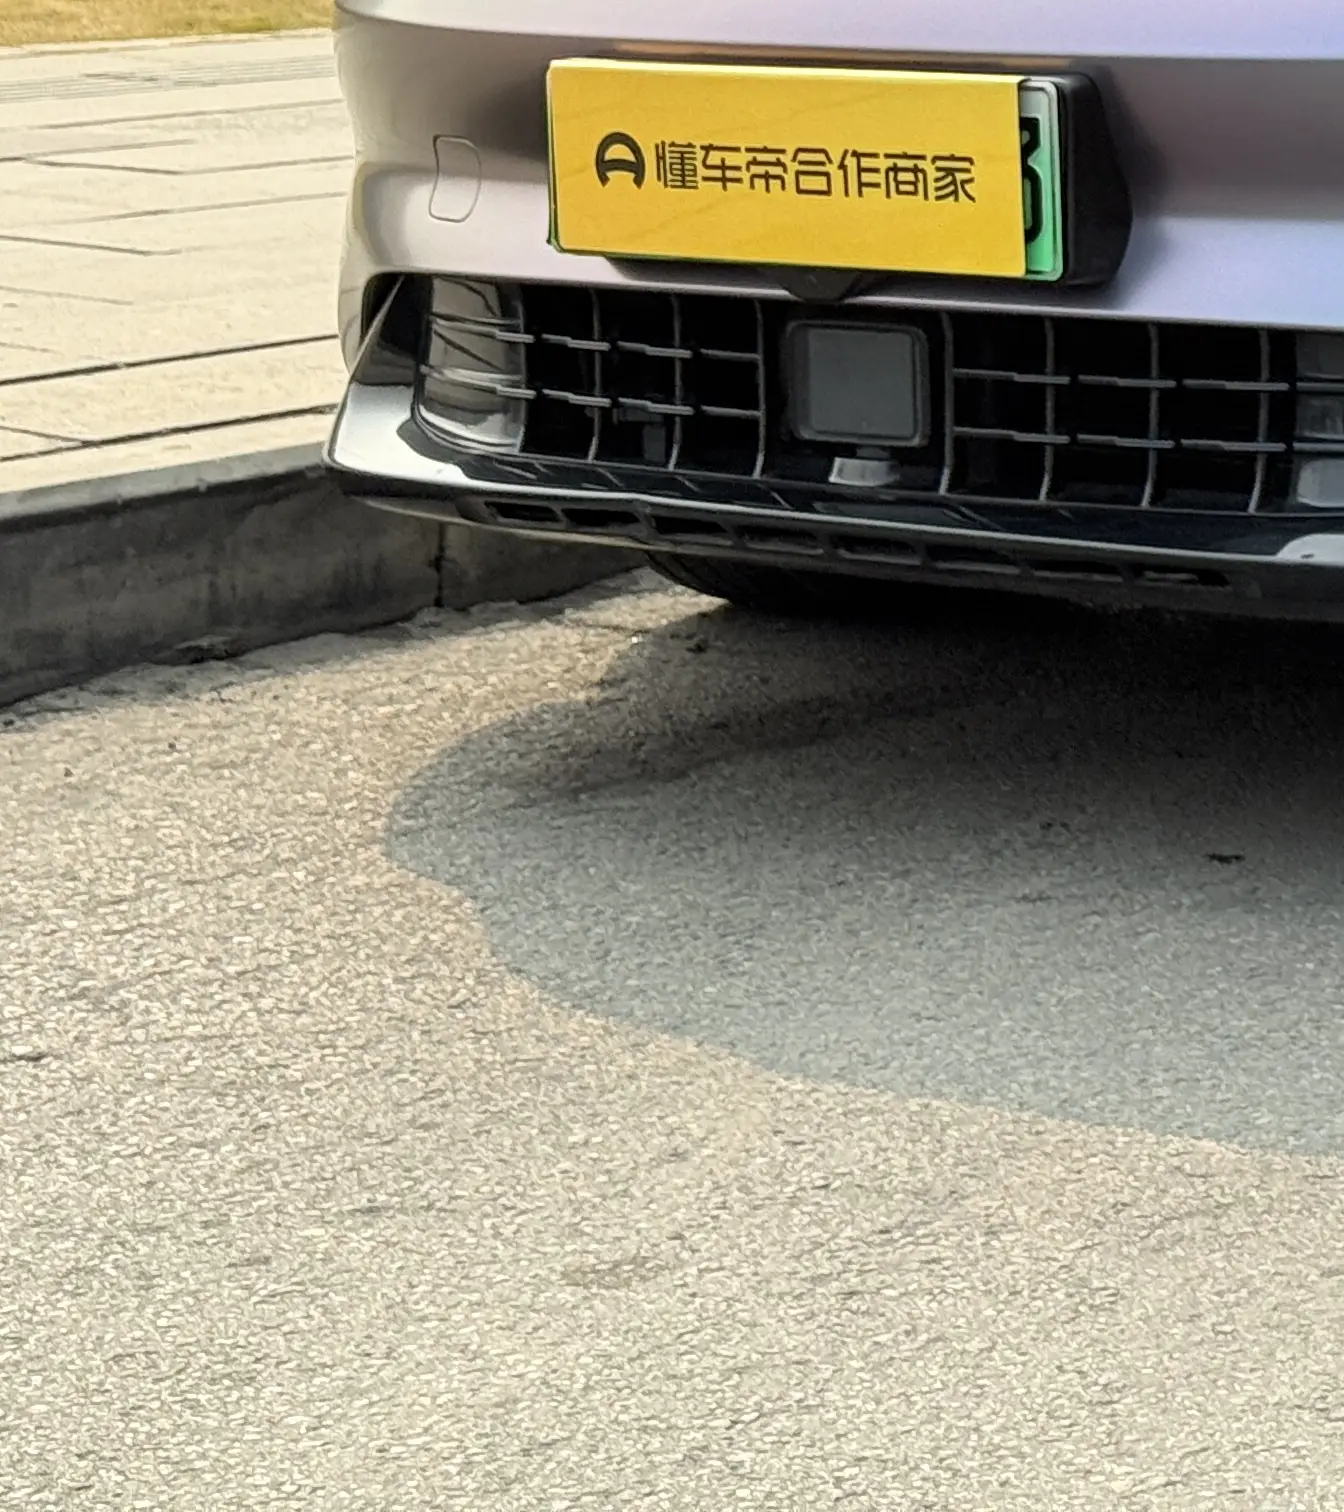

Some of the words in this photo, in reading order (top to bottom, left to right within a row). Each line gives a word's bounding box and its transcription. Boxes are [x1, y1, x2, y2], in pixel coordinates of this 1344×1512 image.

[654, 140, 976, 203] 懂车帝合作商家
